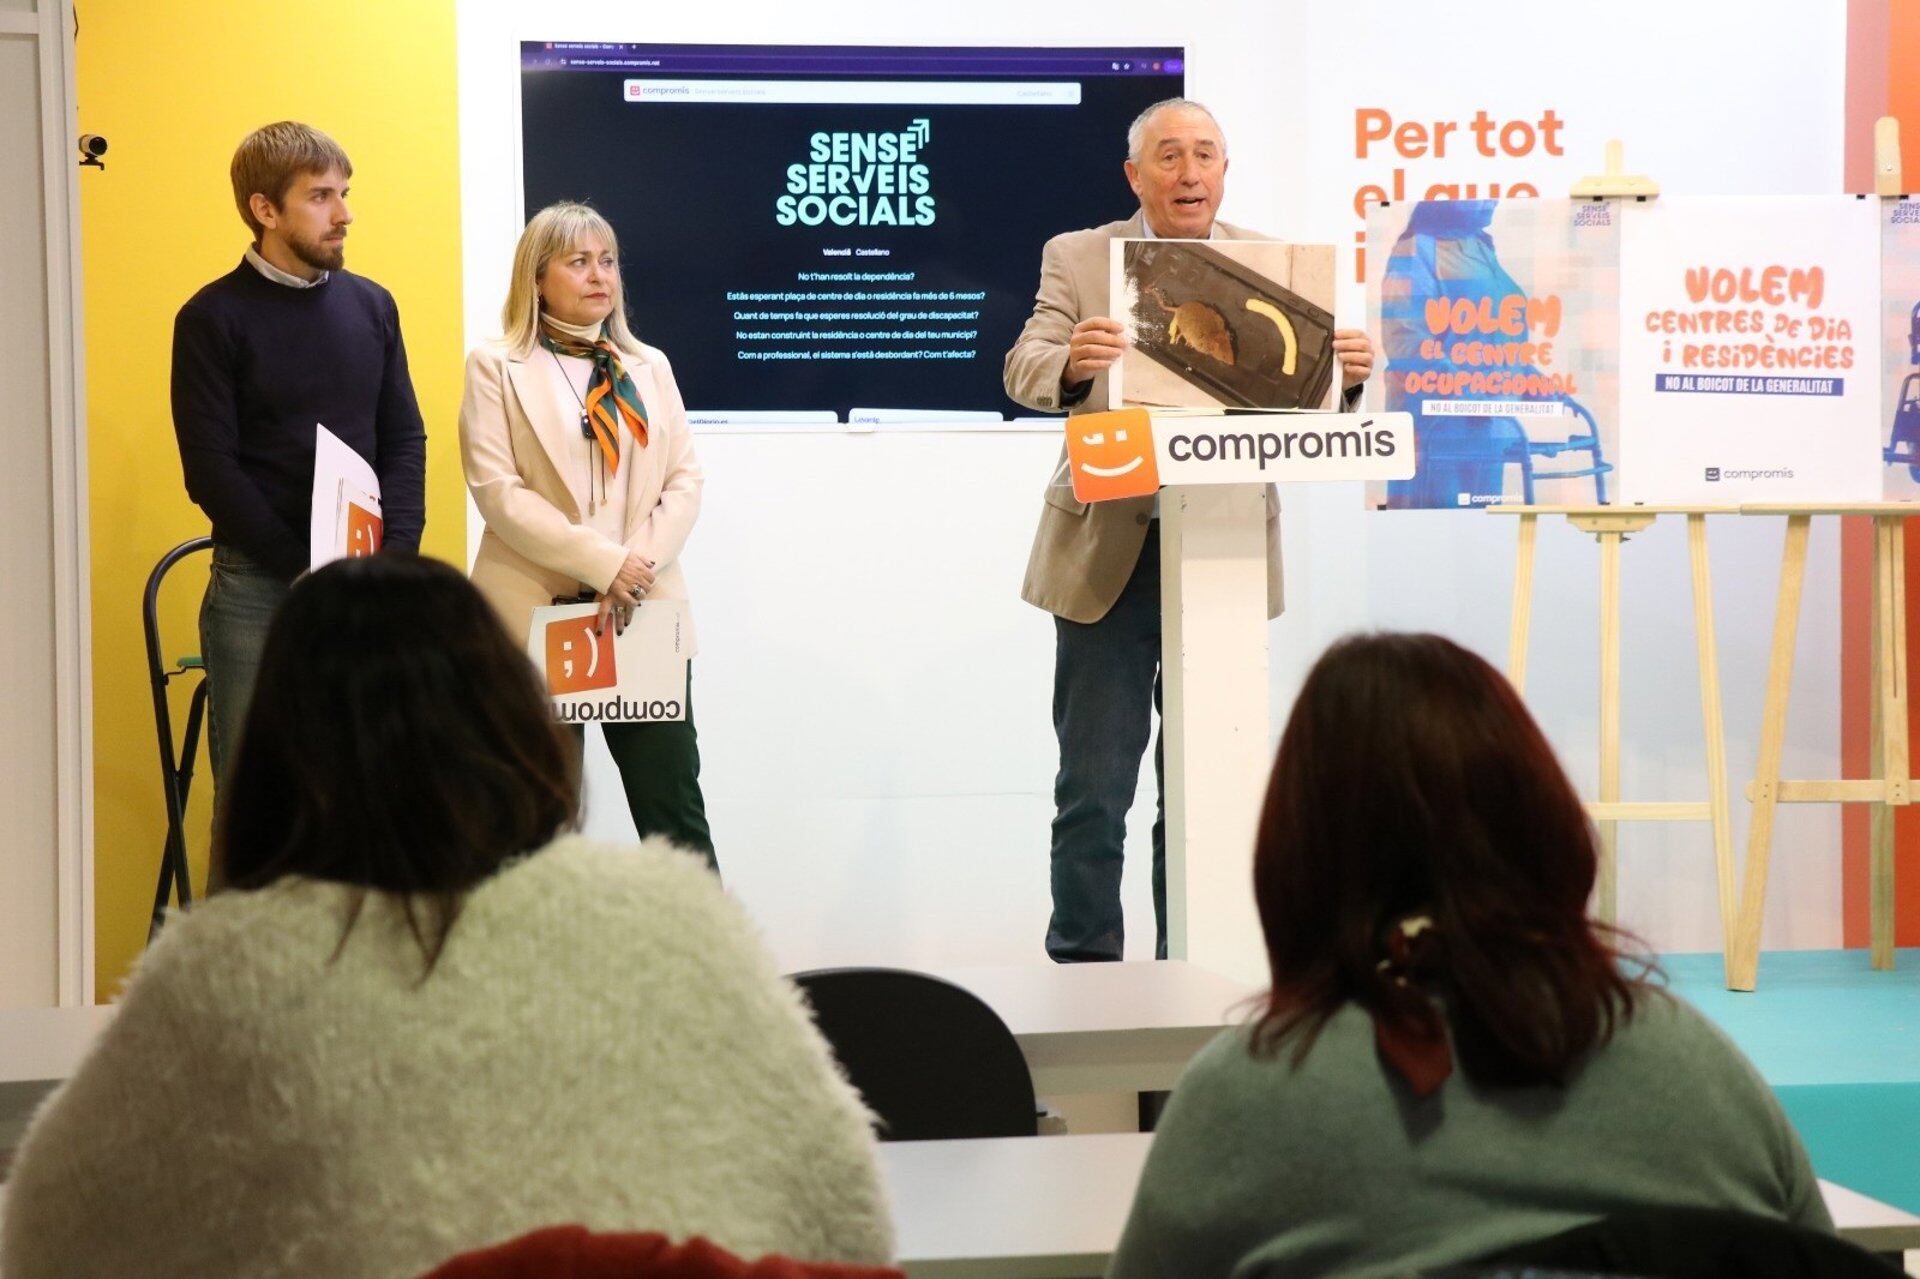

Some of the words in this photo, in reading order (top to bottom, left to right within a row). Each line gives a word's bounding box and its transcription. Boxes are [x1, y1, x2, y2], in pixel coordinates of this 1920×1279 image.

[1355, 108, 1457, 159] Per
[1470, 110, 1564, 158] tot
[810, 131, 918, 163] SENSE
[786, 163, 931, 195] SERVEIS
[775, 195, 937, 227] SOCIALS
[798, 272, 810, 281] No
[830, 272, 853, 281] resolt
[853, 272, 861, 281] la
[1684, 264, 1825, 309] VOLEM
[749, 292, 784, 302] esperant
[806, 292, 816, 301] de
[816, 292, 842, 301] centre
[843, 292, 854, 301] de
[866, 292, 872, 301] o
[912, 292, 920, 301] fa
[938, 292, 949, 301] de
[949, 292, 954, 301] 6
[955, 292, 985, 301] mesos?
[734, 311, 758, 320] Quant
[758, 311, 770, 320] de
[770, 311, 794, 321] temps
[795, 311, 803, 320] fa
[803, 311, 819, 321] que
[819, 311, 851, 321] esperes
[886, 311, 898, 320] del
[899, 311, 917, 321] grau
[917, 311, 928, 320] de
[928, 311, 979, 321] discapacitat?
[1425, 294, 1562, 337] VOLEM
[1645, 309, 1764, 334] CENTRES
[736, 331, 748, 339] No
[748, 331, 771, 339] estan
[771, 331, 811, 339] construint
[812, 331, 819, 339] la
[859, 331, 866, 339] o
[866, 331, 891, 339] centre
[891, 331, 902, 339] de
[914, 331, 927, 339] del
[927, 331, 941, 339] teu
[941, 331, 978, 340] municipi?
[738, 350, 757, 359] Com
[757, 350, 763, 359] a
[812, 350, 820, 359] el
[820, 350, 851, 359] sistema
[923, 350, 943, 359] Com
[1419, 339, 1445, 361] EL
[1450, 341, 1553, 366] CENTRE
[1664, 376, 1681, 390] NO
[1682, 377, 1697, 391] AL
[1697, 377, 1735, 391] BOICOT
[1735, 378, 1750, 392] DE
[1751, 378, 1764, 392] LA
[1765, 379, 1834, 394] GENERALITAT
[1430, 402, 1442, 413] NO
[1443, 402, 1453, 413] AL
[1454, 403, 1481, 413] BOICOT
[1482, 403, 1493, 414] DE
[1494, 403, 1503, 414] LA
[1504, 403, 1555, 414] GENERALITAT
[1168, 419, 1396, 471] compromís
[1723, 467, 1795, 481] compromís
